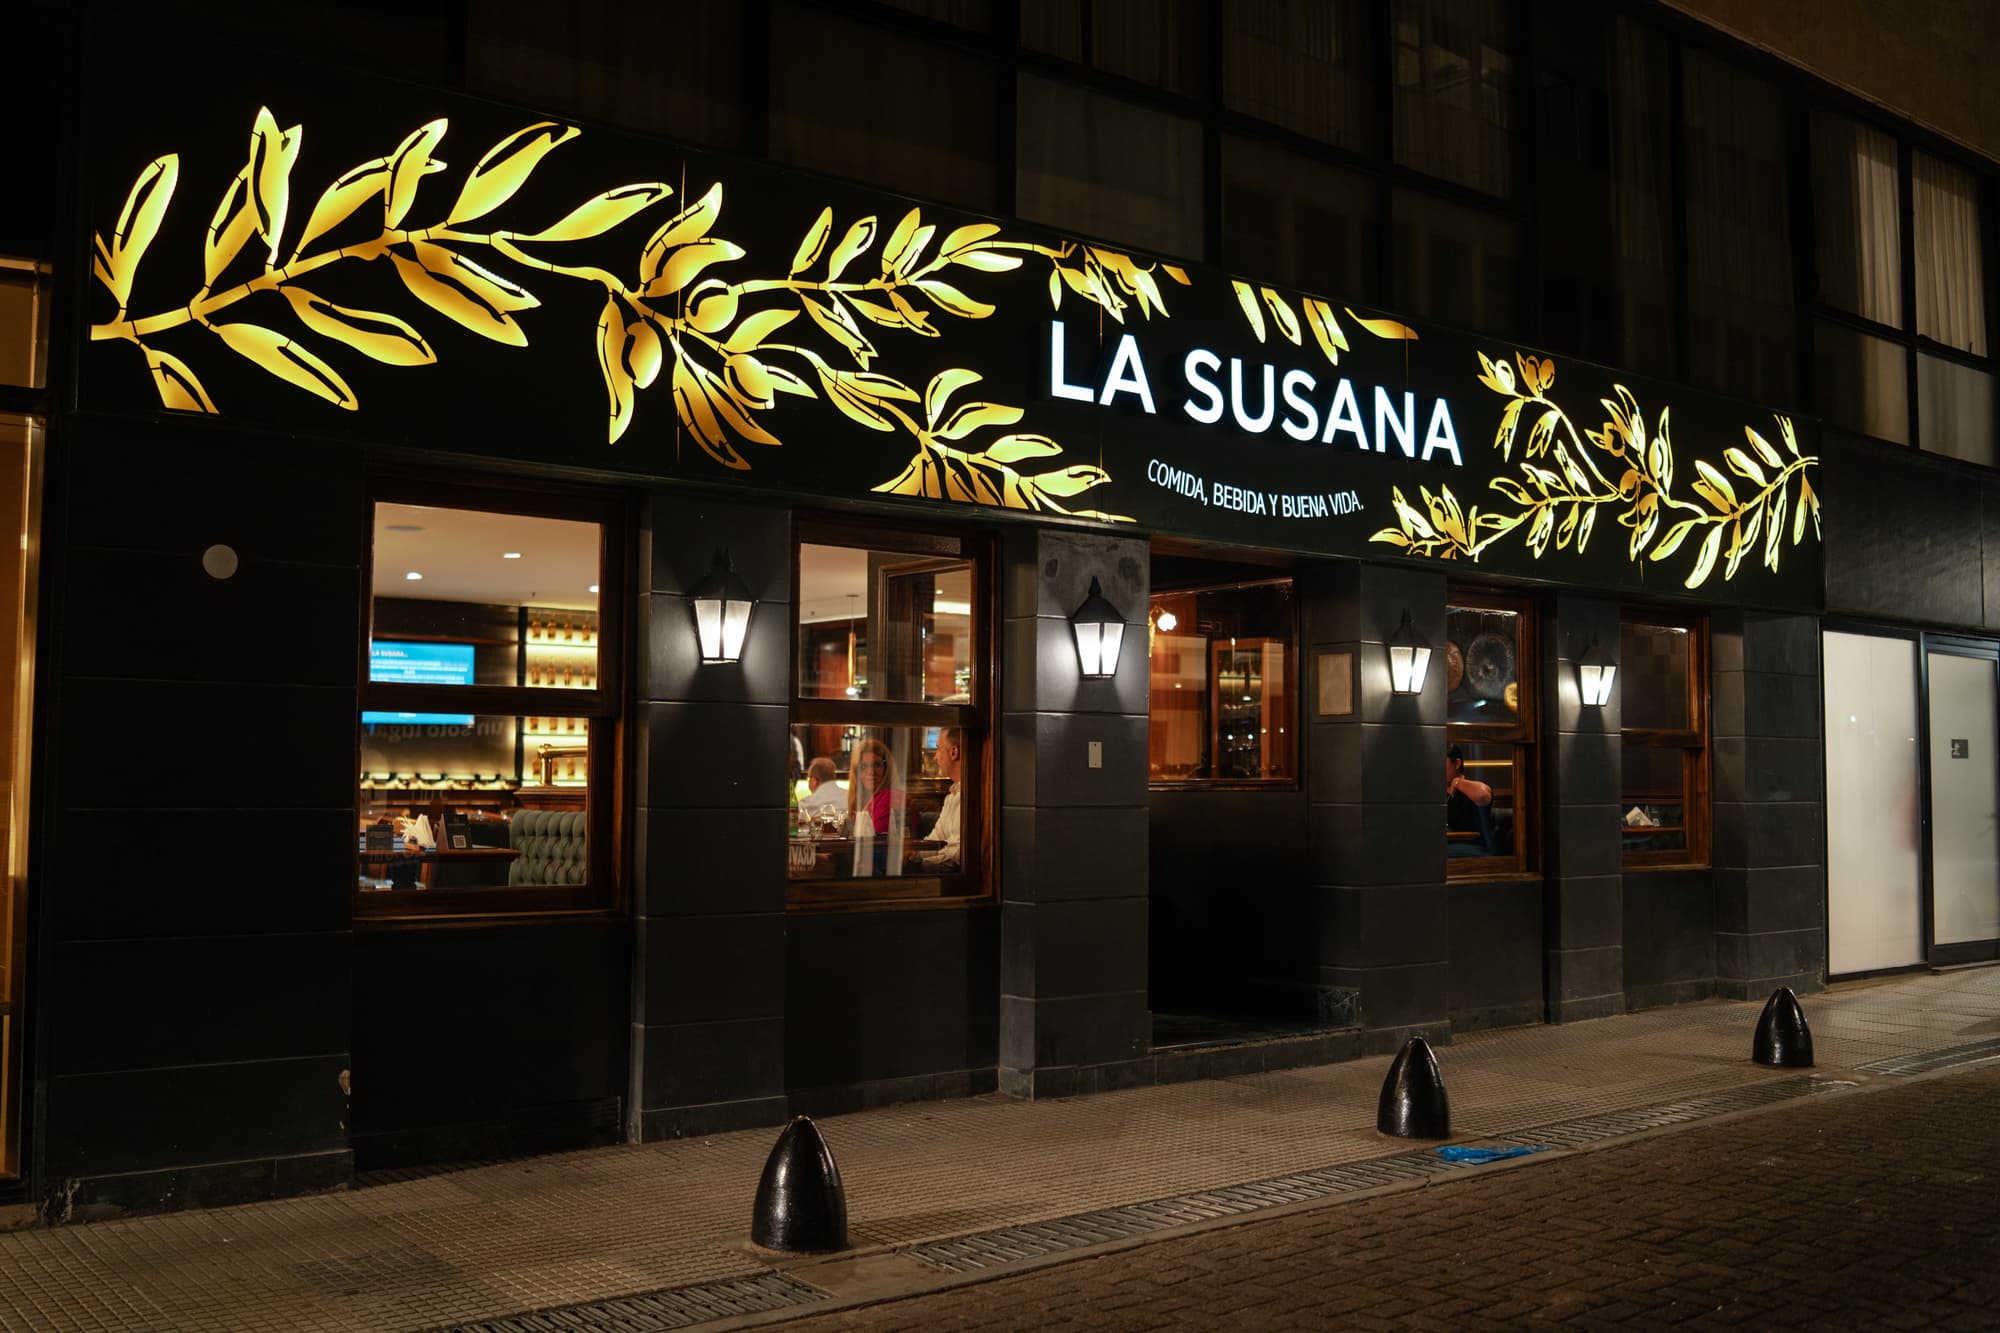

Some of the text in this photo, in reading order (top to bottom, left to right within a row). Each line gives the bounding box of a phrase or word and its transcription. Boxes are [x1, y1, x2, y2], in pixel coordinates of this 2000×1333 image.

[1051, 319, 1463, 466] LA SUSANA
[1148, 459, 1364, 518] COMIDA, BEBIDA Y BUENA VIDA.
